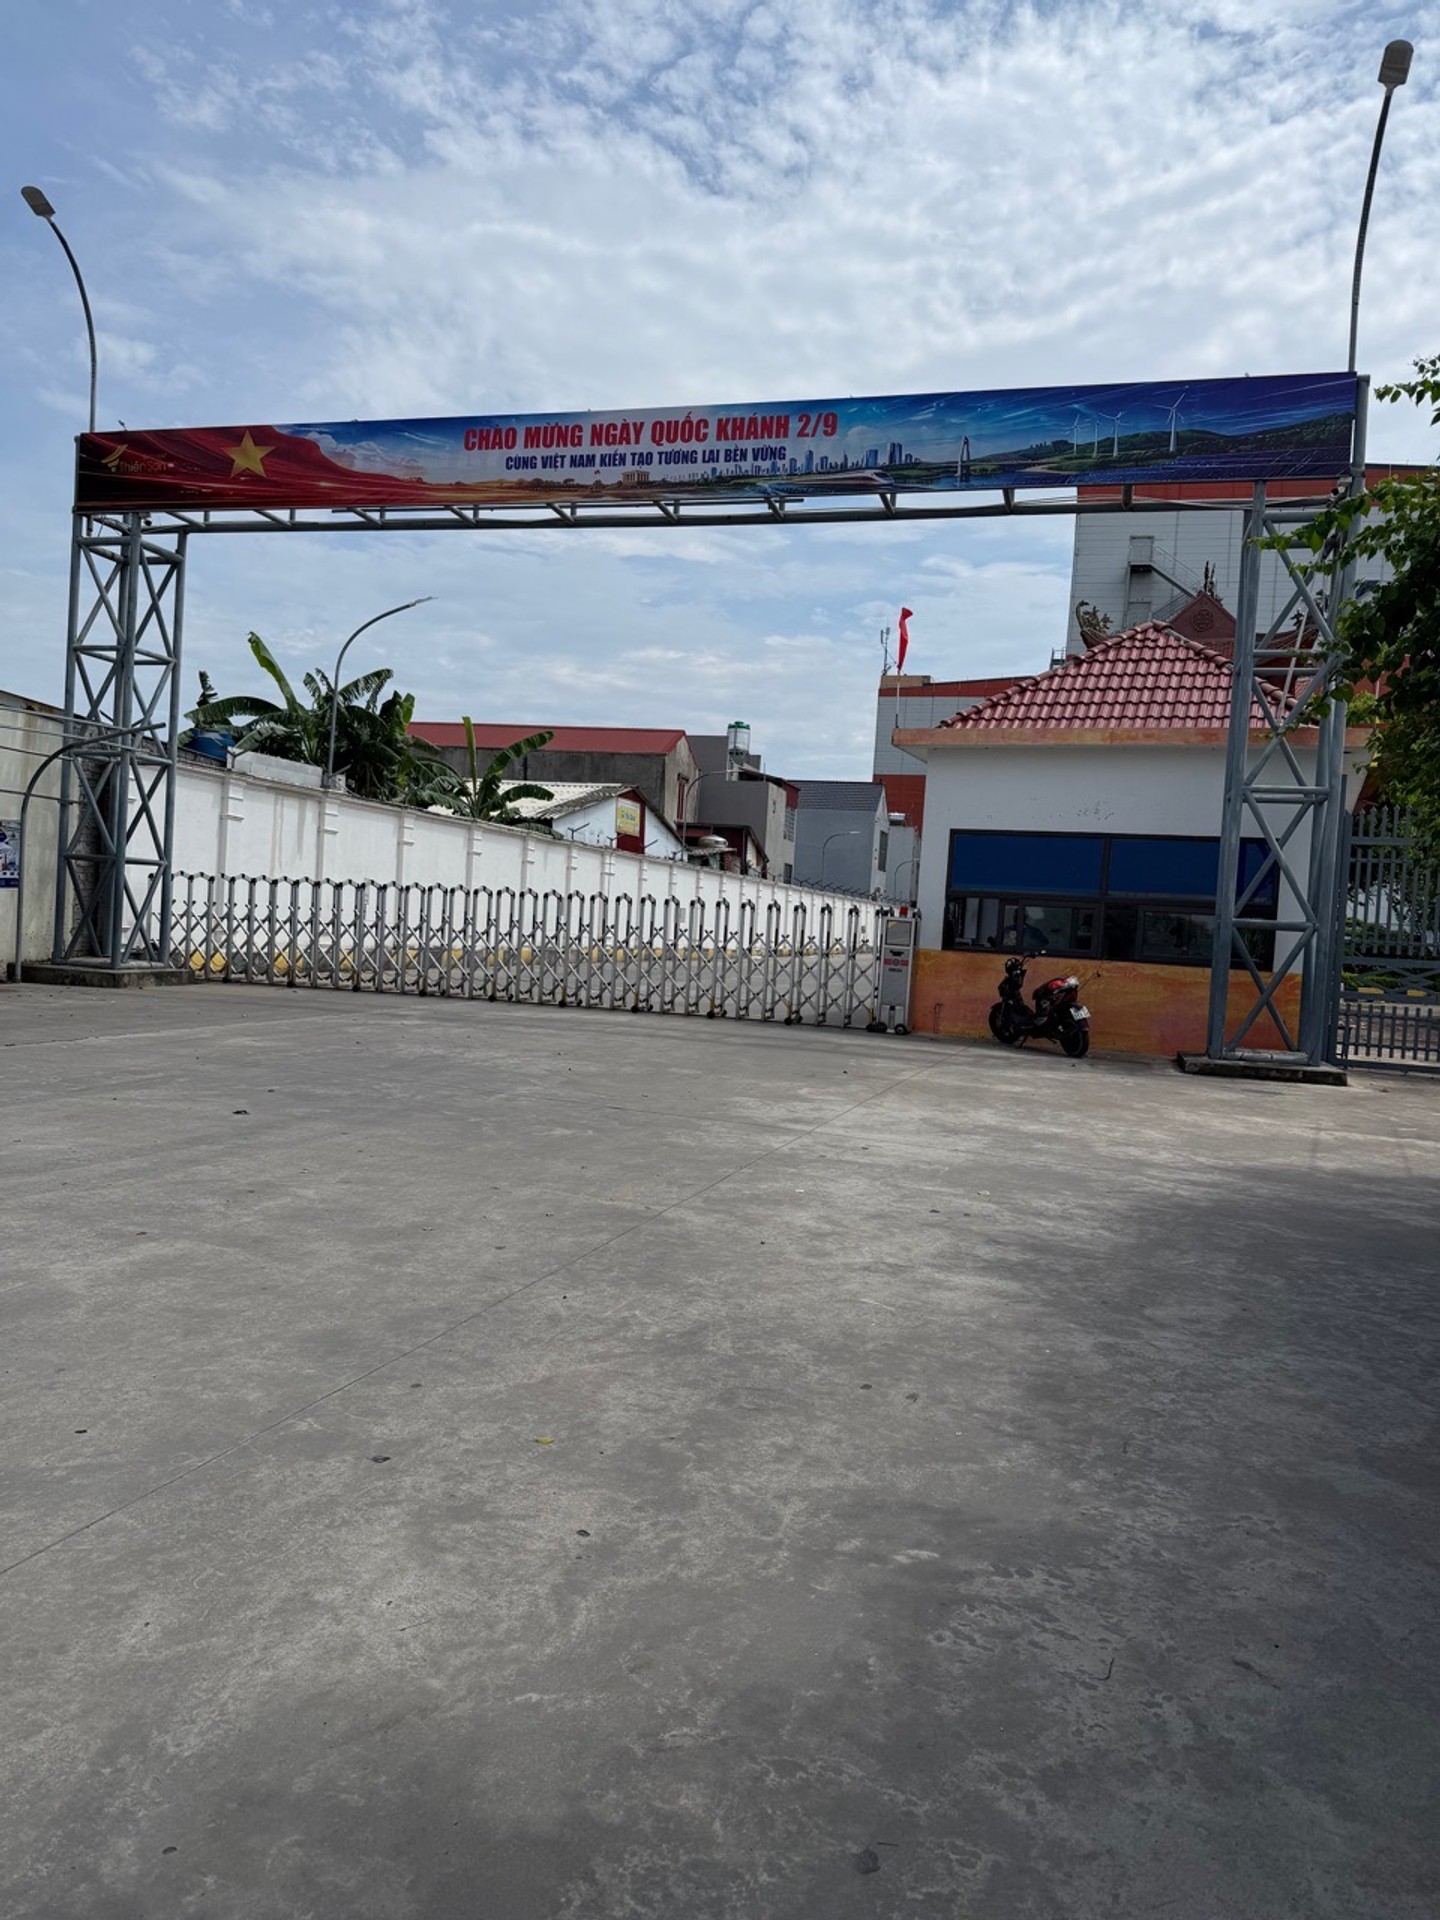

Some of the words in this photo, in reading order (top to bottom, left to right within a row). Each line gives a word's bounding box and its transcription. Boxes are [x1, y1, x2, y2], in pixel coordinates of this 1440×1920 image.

[464, 424, 517, 451] CHÀO
[524, 421, 584, 449] MỪNG
[589, 418, 645, 447] NGÀY
[650, 411, 709, 446] QUỐC
[715, 412, 791, 441] KHÁNH
[796, 412, 838, 438] 2/9
[505, 454, 538, 470] CÙNG
[541, 452, 567, 472] VIỆT
[569, 454, 596, 468] NAM
[629, 451, 654, 469] TẠO
[657, 448, 698, 465] TƯƠNG
[702, 447, 720, 463] LAI
